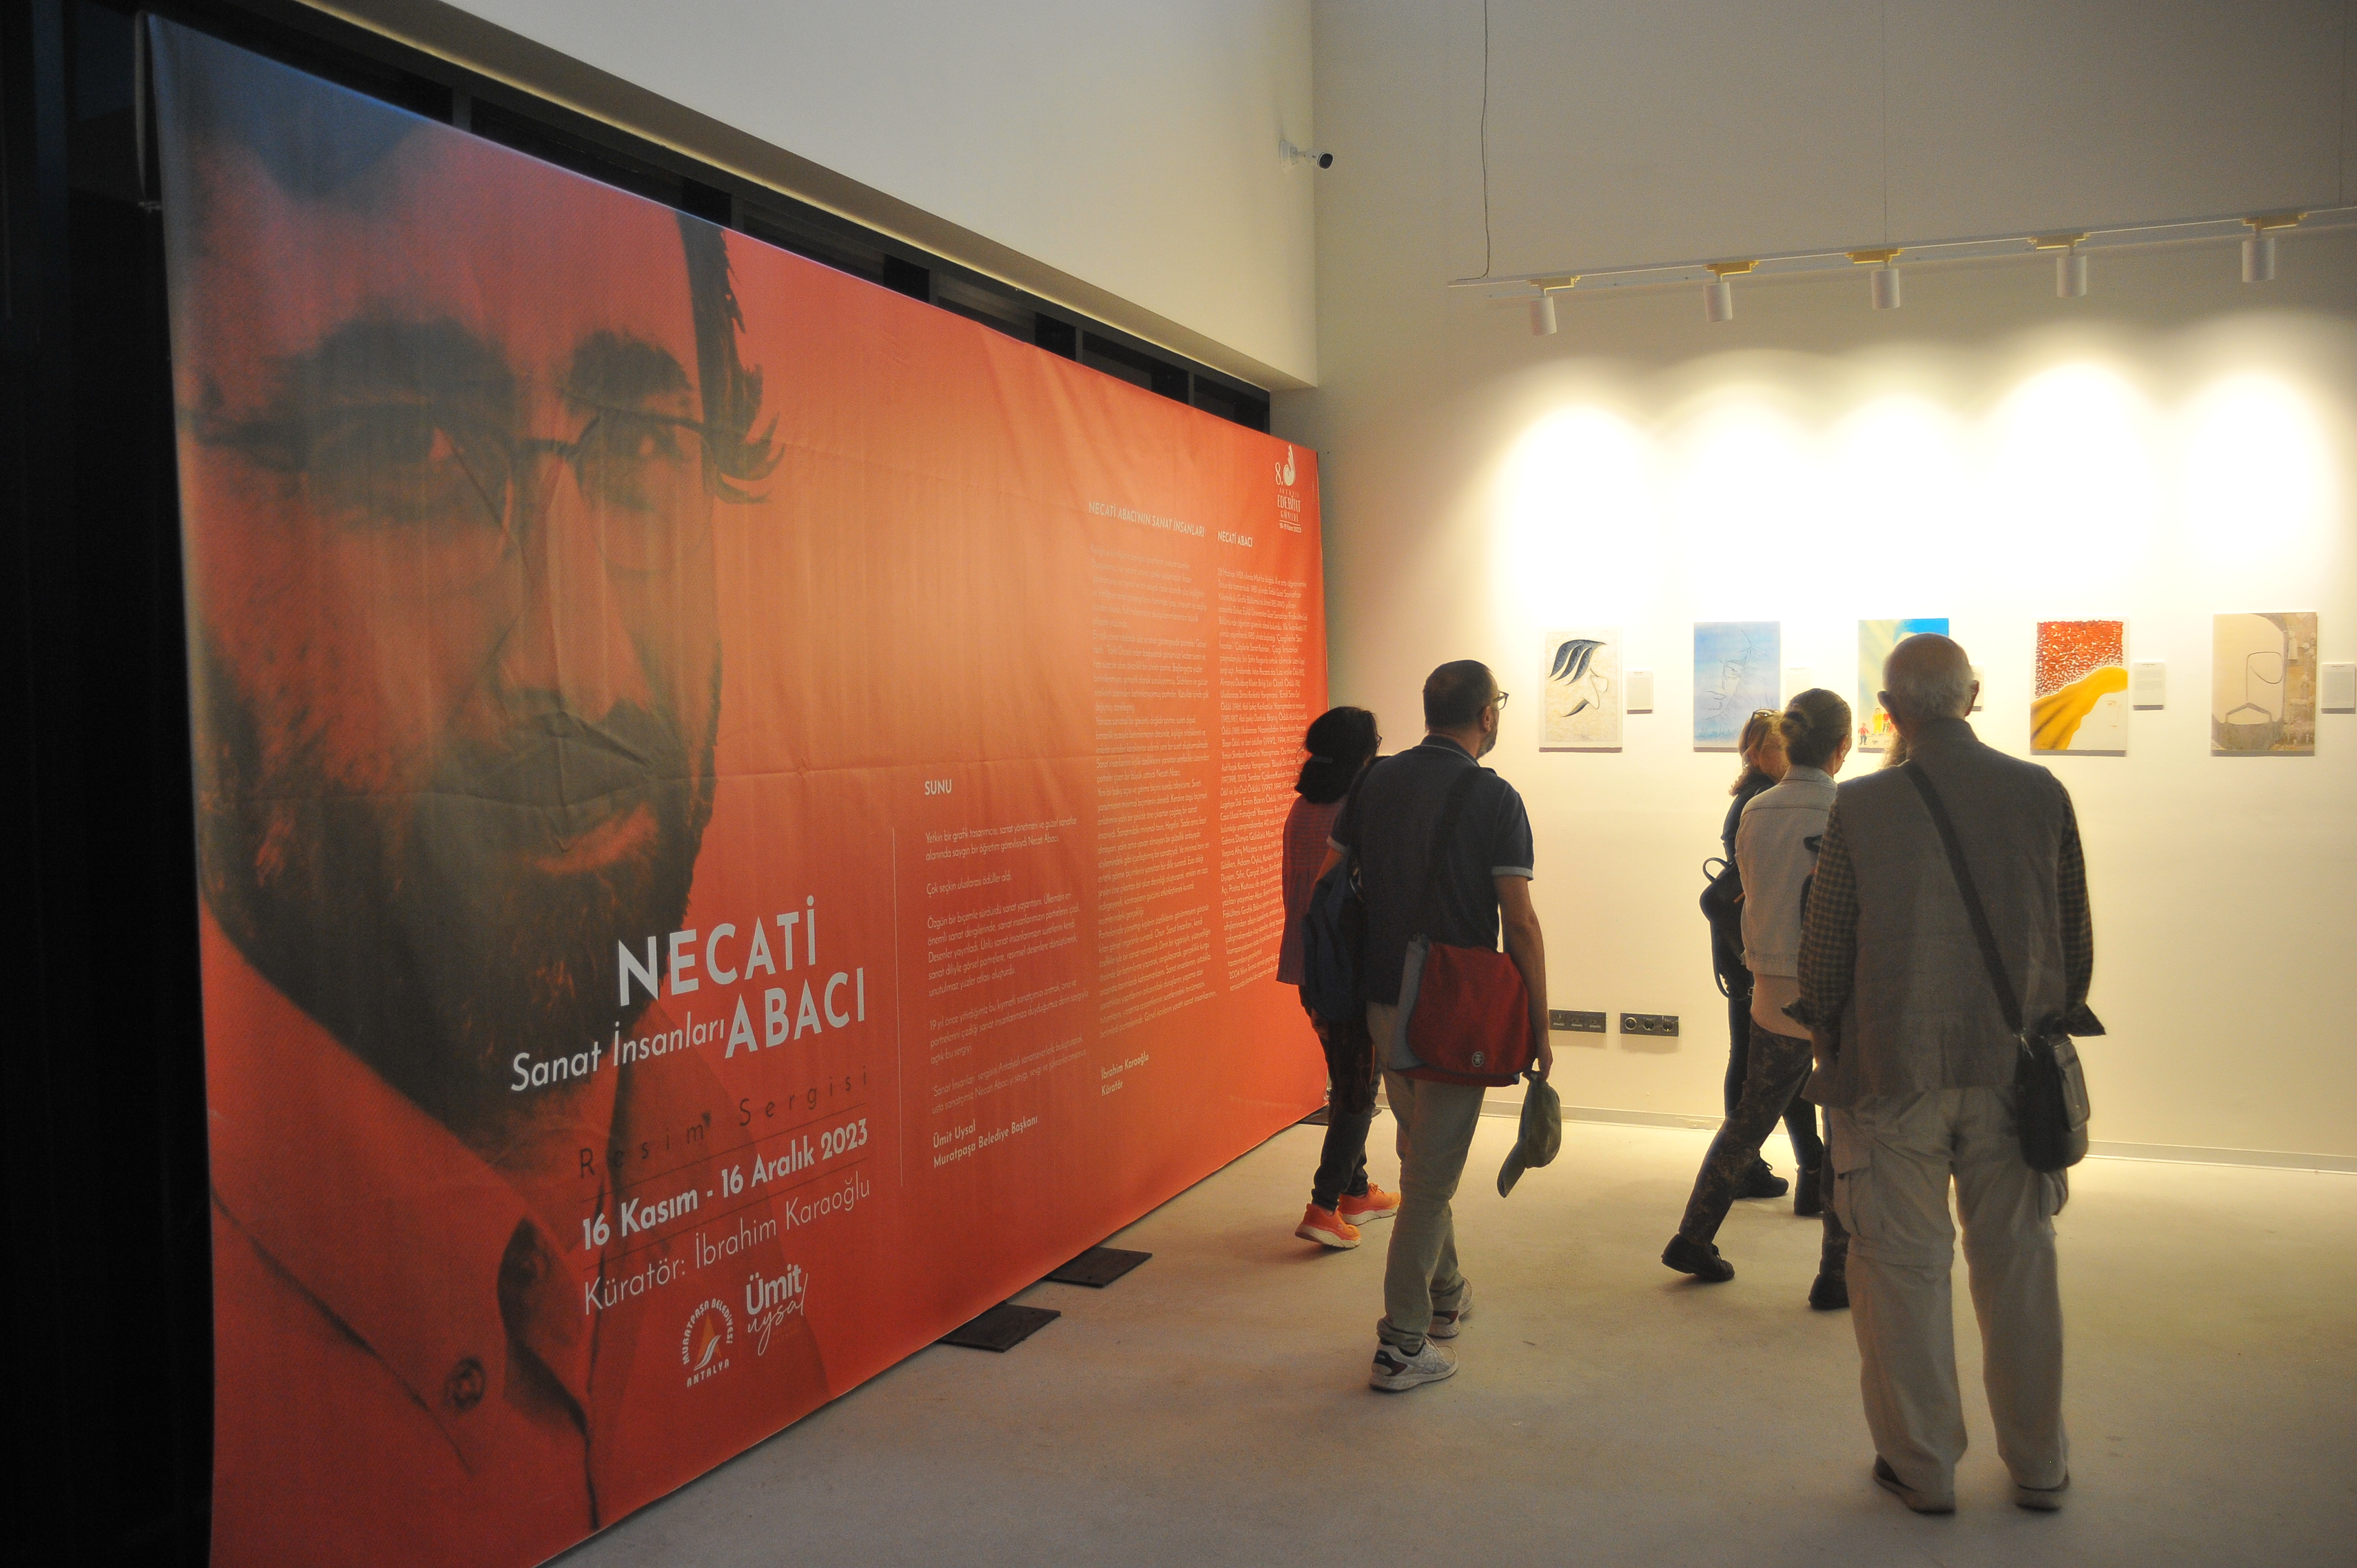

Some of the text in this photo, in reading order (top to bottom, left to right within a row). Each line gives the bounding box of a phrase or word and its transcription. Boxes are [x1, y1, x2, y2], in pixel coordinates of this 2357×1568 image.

[1275, 462, 1283, 486] 8.
[1088, 501, 1205, 537] NECATİ ABACI'NIN SANAT İNSANLARI
[1218, 530, 1253, 548] NECATİ ABACI
[924, 779, 953, 796] SUNU
[925, 831, 942, 843] Yetkin
[953, 827, 969, 842] grafik
[1000, 826, 1013, 835] sanat
[1046, 817, 1058, 831] güzel
[926, 847, 951, 861] alanında
[953, 847, 970, 858] saygın
[980, 842, 1000, 855] öğretim
[1028, 835, 1044, 846] Necati
[927, 883, 938, 898] Çok
[940, 879, 956, 895] seçkin
[983, 872, 1000, 885] ödüller
[928, 917, 948, 929] Özgün
[958, 908, 978, 925] biçemle
[1003, 903, 1016, 912] sanat
[928, 932, 947, 946] önemli
[948, 932, 964, 941] sanat
[998, 921, 1012, 930] sanat
[618, 895, 816, 1007] NECATİ
[928, 948, 953, 963] Desenler
[981, 937, 993, 950] Ünlü
[994, 936, 1008, 946] sanat
[929, 969, 945, 980] sanat
[963, 956, 979, 973] görsel
[929, 981, 959, 997] unutulmaz
[724, 967, 865, 1059] ABACI
[945, 1016, 958, 1026] önce
[989, 1003, 996, 1013] bu
[979, 1021, 994, 1032] sanat
[511, 1011, 724, 1092] Sanat İnsanları
[945, 1048, 953, 1059] bu
[1101, 1050, 1149, 1080] İbrahim Karaoğlu
[1102, 1080, 1123, 1096] Küratör
[579, 1065, 867, 1179] Resim Sergisi
[933, 1118, 975, 1148] Ümit Uysal
[934, 1116, 1038, 1168] Muratpaşa Belediye Başkanı
[583, 1212, 610, 1250] 16
[621, 1188, 698, 1237] Kasım
[722, 1164, 744, 1199] 16
[751, 1135, 815, 1188] Aralık
[820, 1118, 868, 1160] 2023
[584, 1170, 870, 1316] Küratör: İbrahim Karaoğlu
[746, 1263, 802, 1315] Ümit
[682, 1300, 709, 1365] MURATPAŞA
[687, 1358, 729, 1388] ANTALYA
